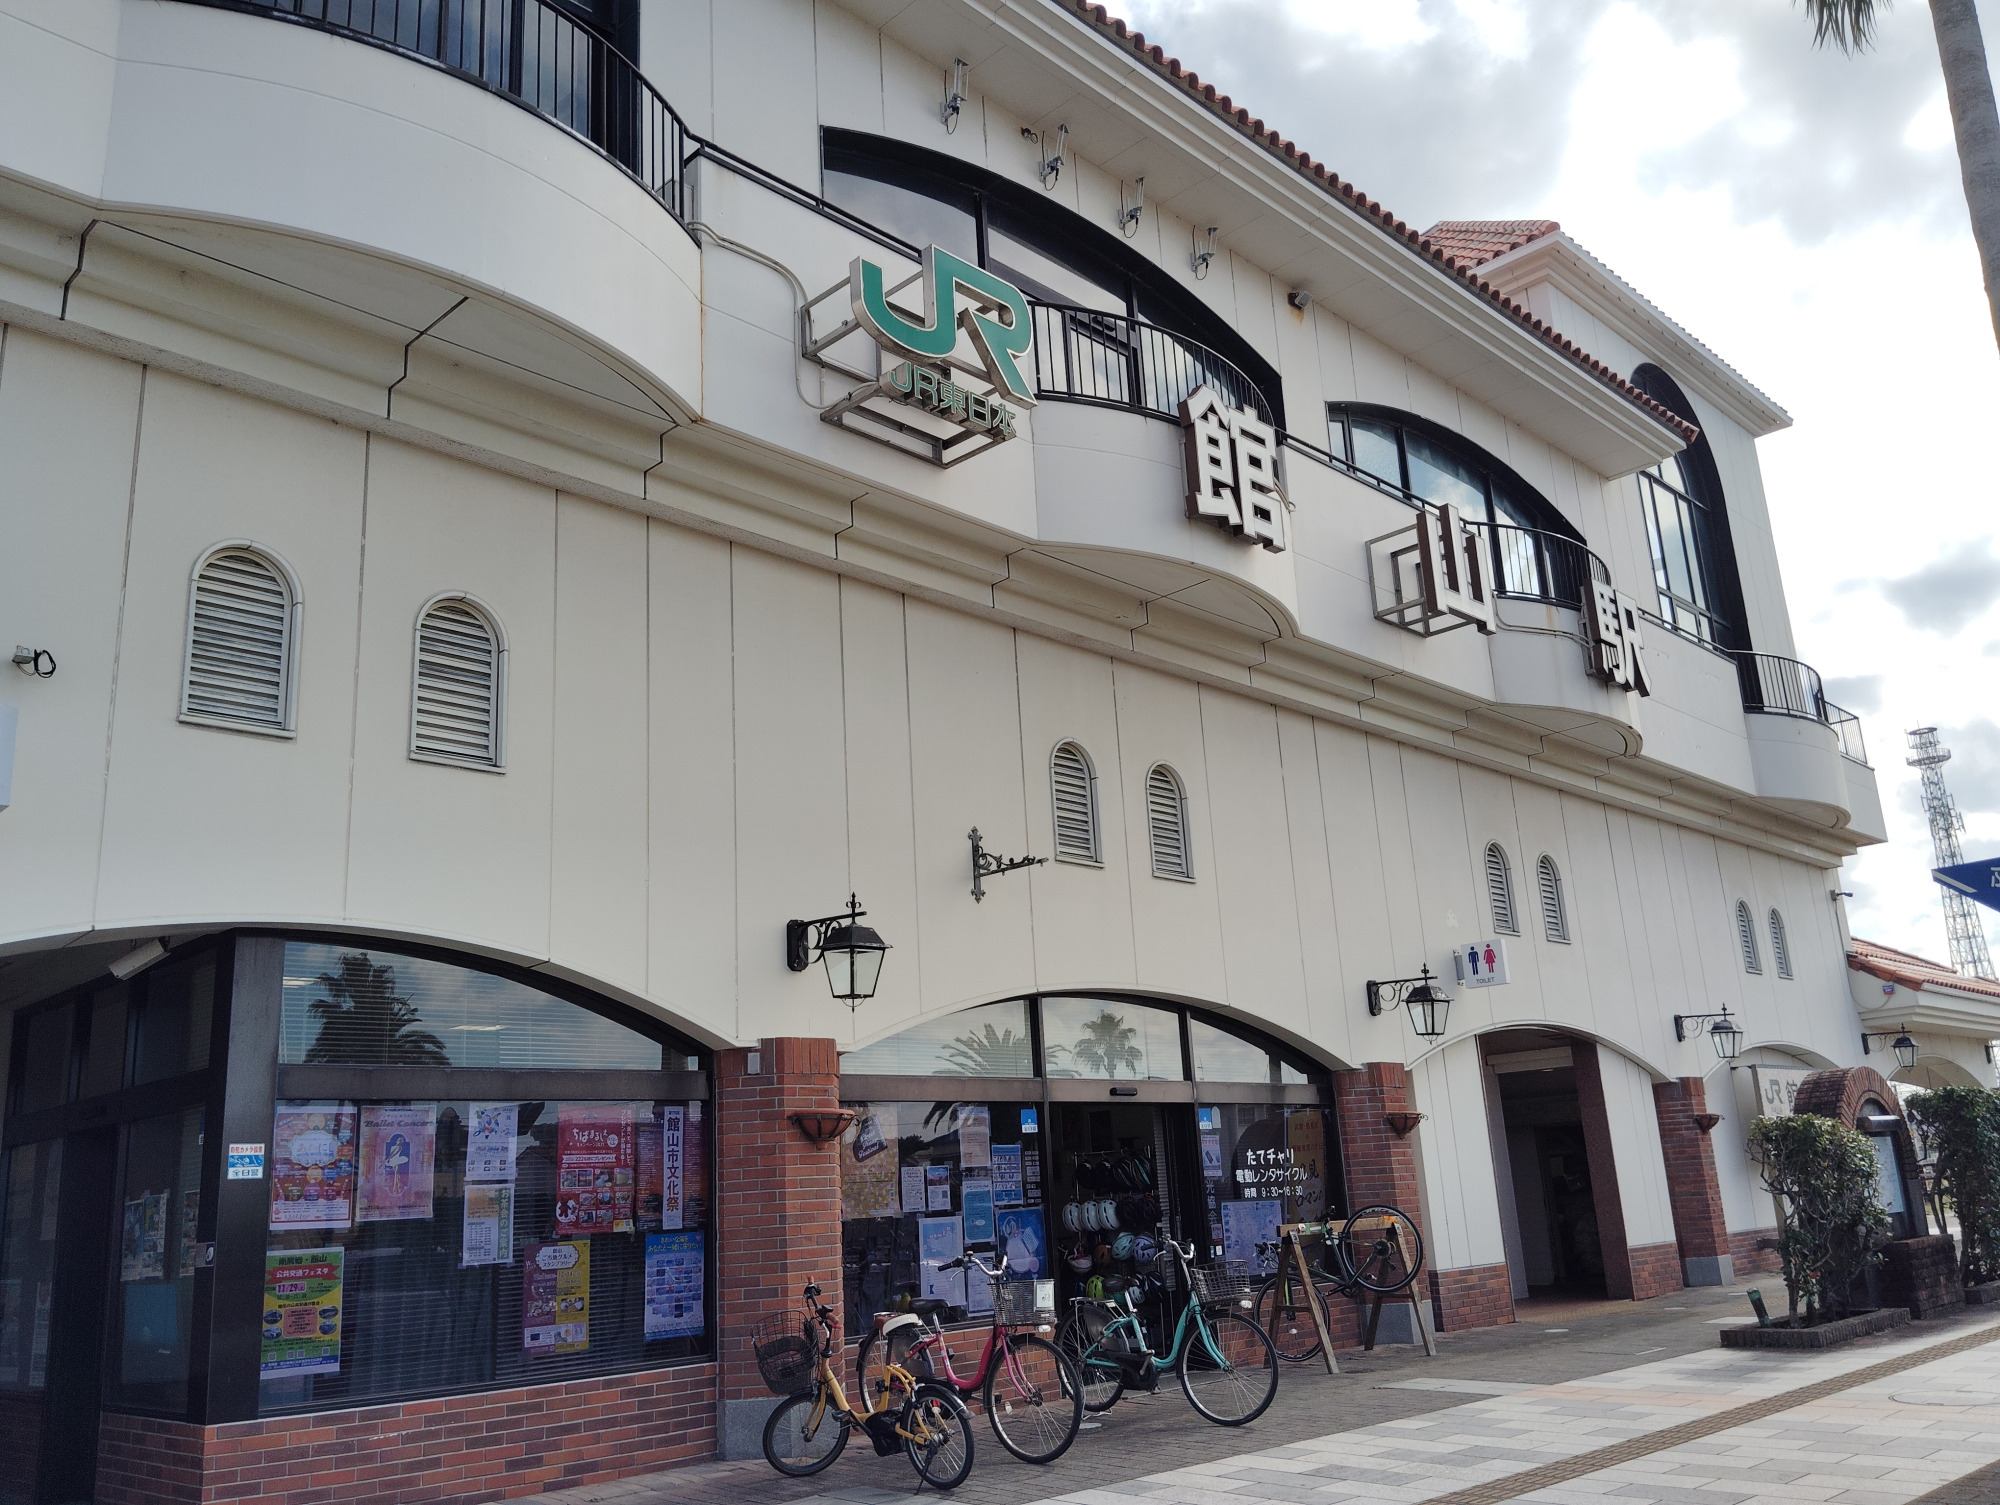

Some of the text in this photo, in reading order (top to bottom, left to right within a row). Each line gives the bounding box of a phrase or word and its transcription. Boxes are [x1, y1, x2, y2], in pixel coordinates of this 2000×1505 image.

[851, 245, 1037, 408] JR
[890, 361, 1017, 438] JR東日本
[1475, 976, 1495, 985] TOILET
[1765, 1079, 1784, 1105] JR
[666, 1116, 680, 1212] 館山市文化祭
[1246, 1148, 1294, 1165] たてチャリ
[1235, 1167, 1308, 1183] 電動レンタサイクル
[1244, 1187, 1257, 1198] 時間
[499, 1188, 509, 1258] お茶会のご案内
[276, 1268, 329, 1278] 公共交通フェスタ
